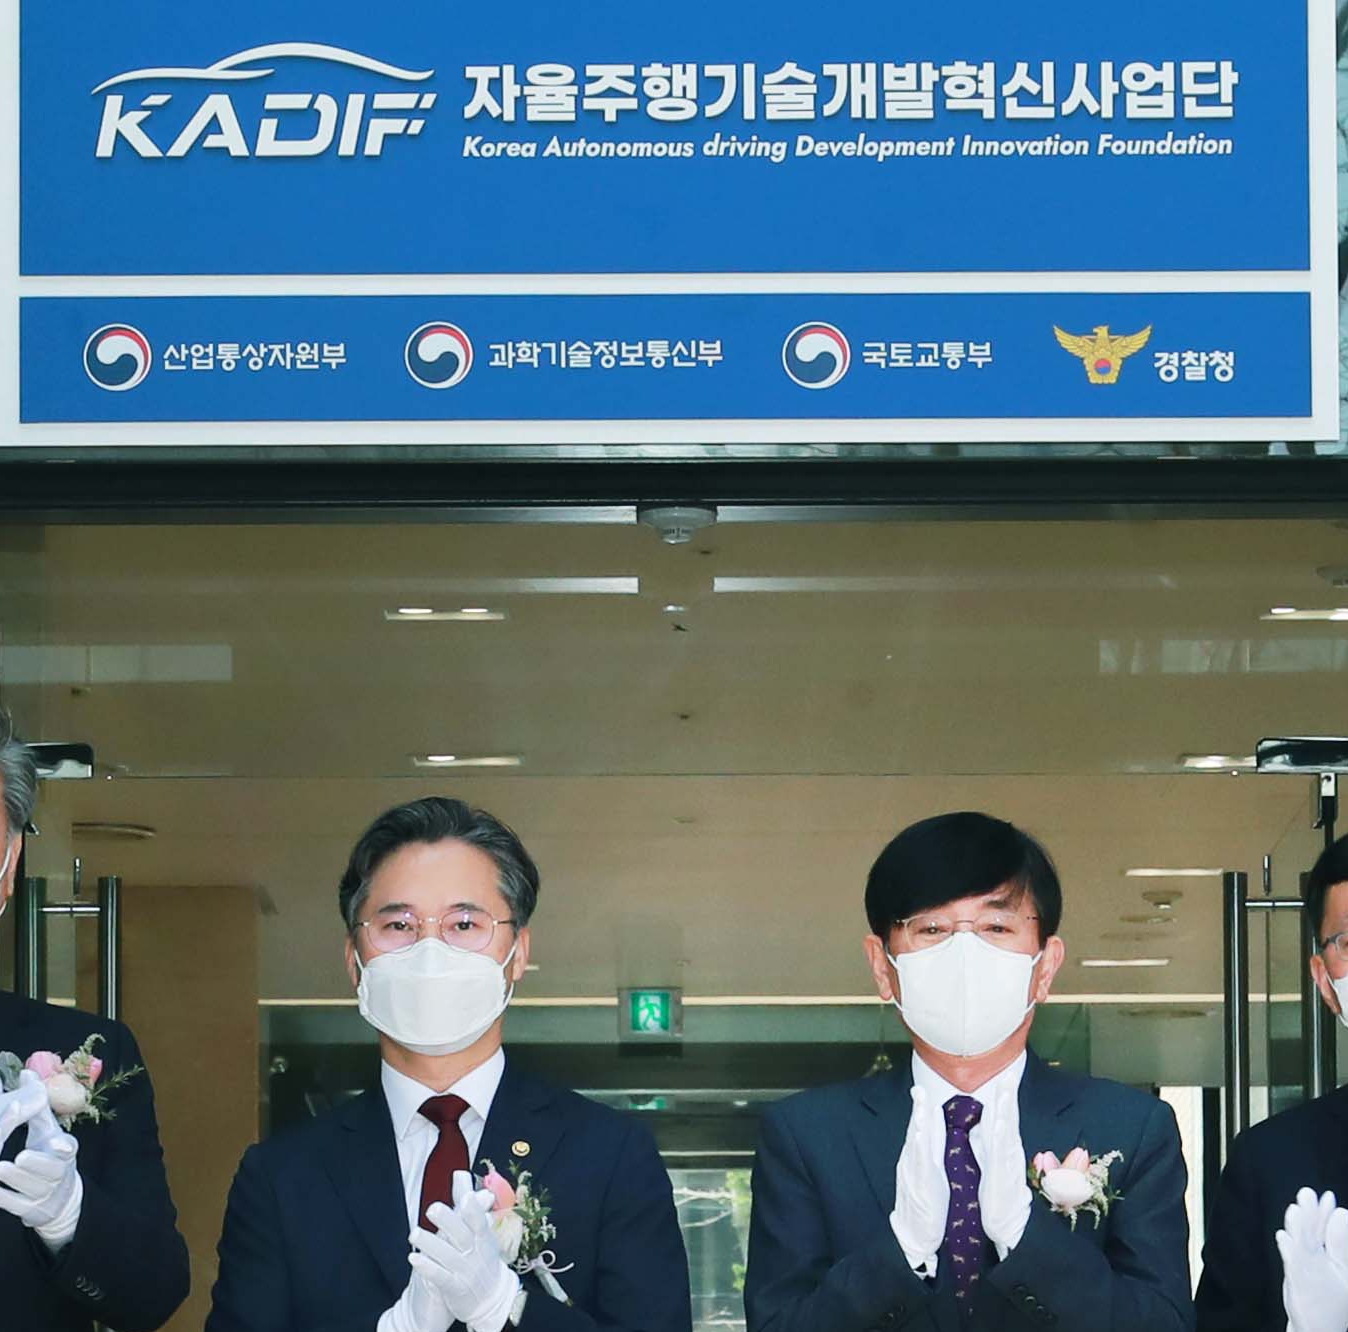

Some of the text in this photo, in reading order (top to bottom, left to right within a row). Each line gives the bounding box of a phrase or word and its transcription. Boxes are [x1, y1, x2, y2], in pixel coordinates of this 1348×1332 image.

[463, 60, 1240, 123] 자율주행기술개발혁신사업단
[94, 92, 439, 158] KADIF
[462, 131, 1233, 164] Korea Autonomous driving Development Innovation Foundation
[163, 341, 347, 372] 산업통상자원부
[488, 339, 724, 369] 과학기술정보통신부
[861, 341, 993, 370] 국토교통부
[1153, 349, 1235, 383] 경찰청
